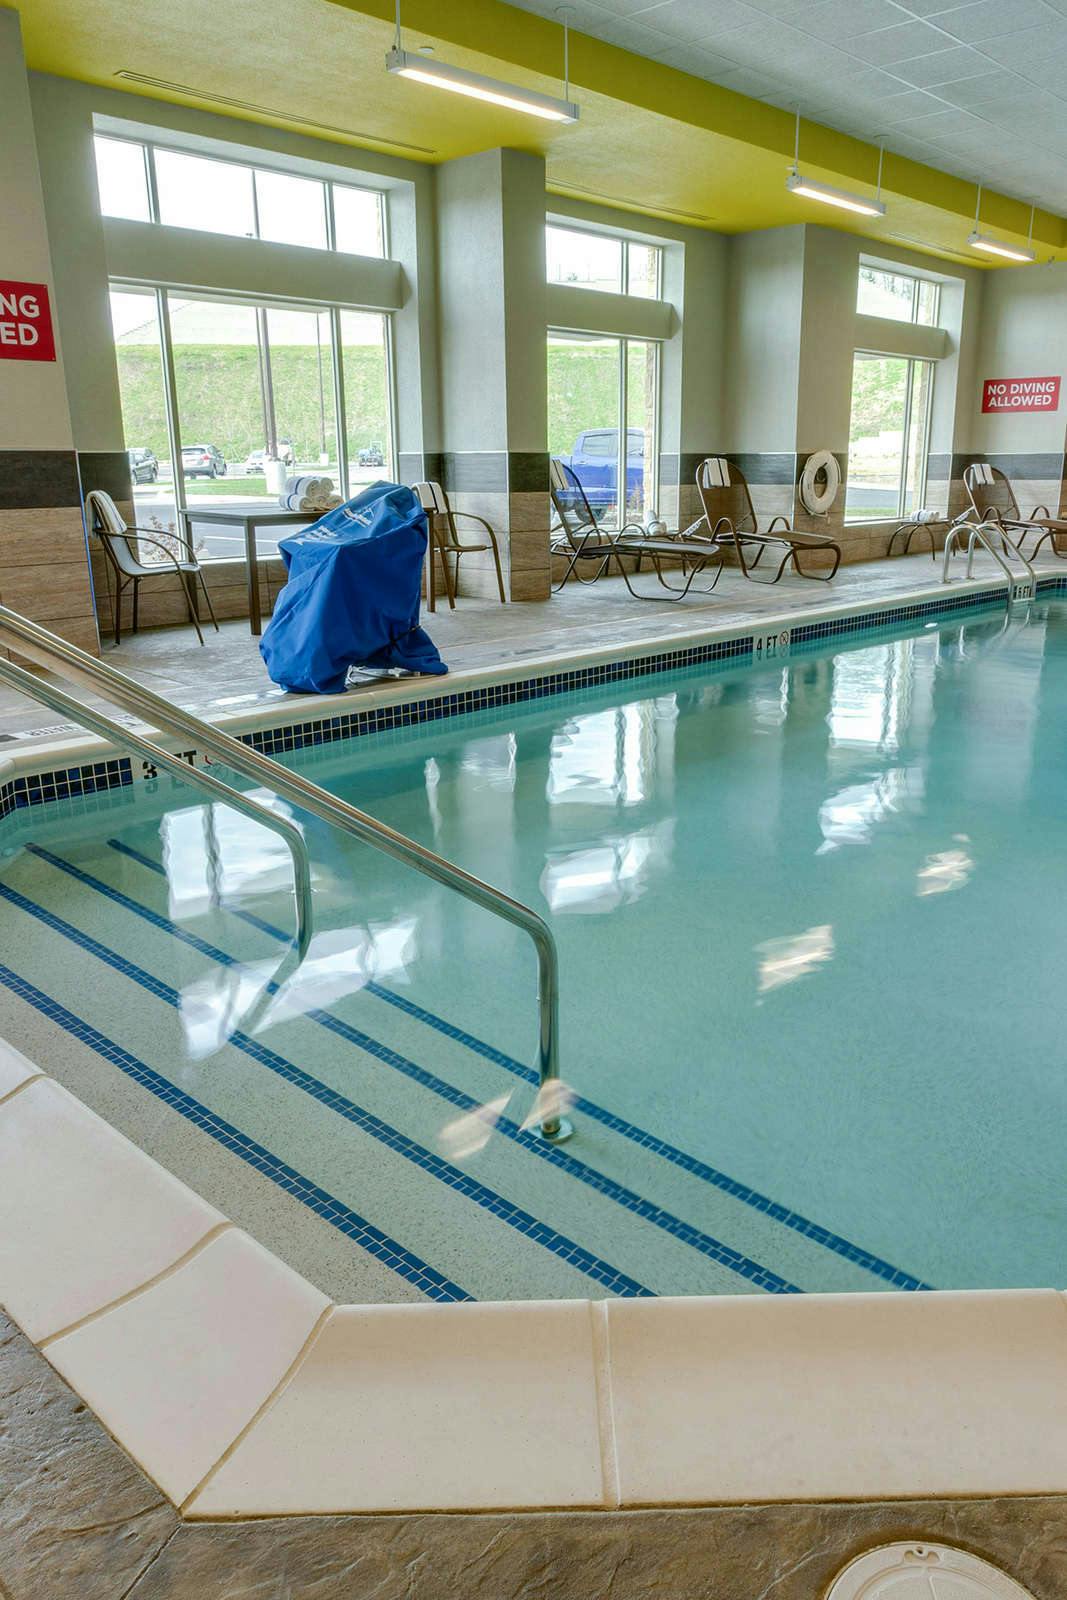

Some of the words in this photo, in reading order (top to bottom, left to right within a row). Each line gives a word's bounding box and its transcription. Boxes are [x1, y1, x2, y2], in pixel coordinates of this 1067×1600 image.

[0, 322, 39, 346] ED
[987, 384, 1007, 395] NO
[1010, 382, 1056, 394] DIVING
[988, 395, 1053, 407] ALLOWED
[756, 638, 763, 650] 4
[766, 635, 778, 649] FT
[142, 761, 158, 780] 3
